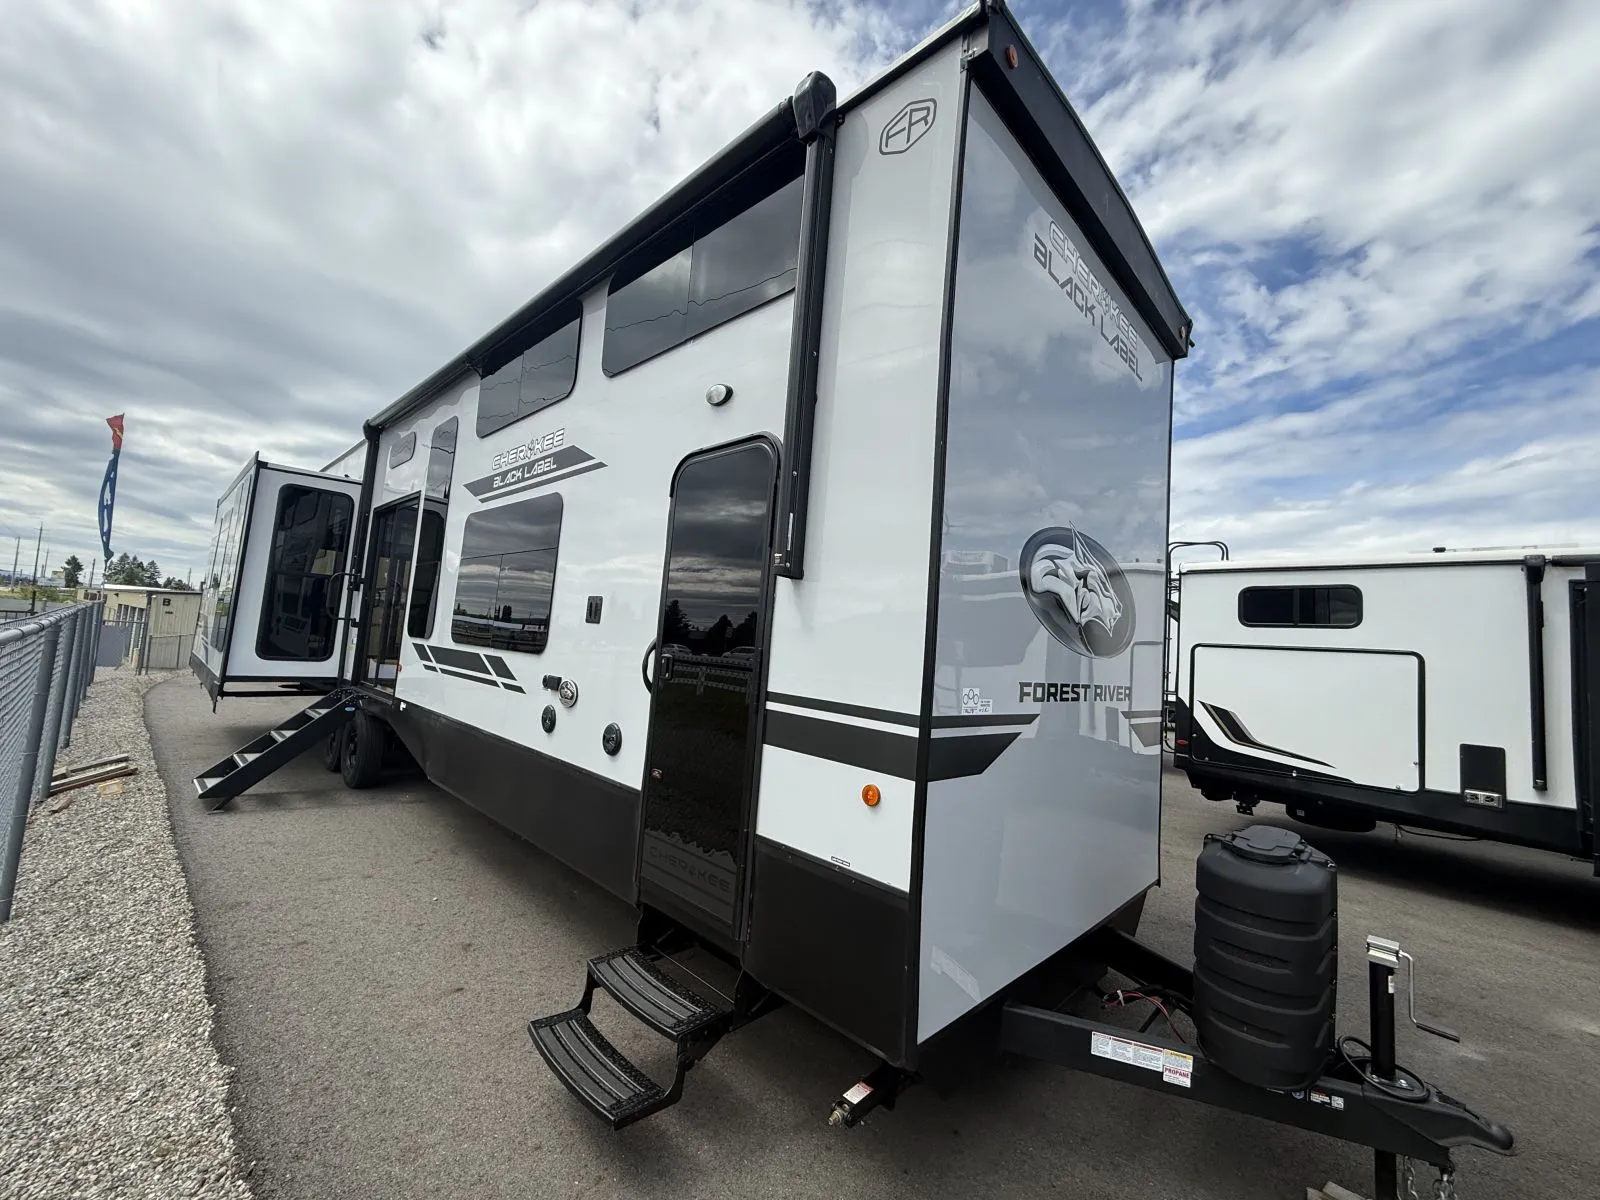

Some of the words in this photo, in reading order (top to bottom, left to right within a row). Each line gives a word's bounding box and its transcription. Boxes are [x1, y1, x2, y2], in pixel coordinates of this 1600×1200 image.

[1033, 232, 1096, 326] BLACK
[1100, 314, 1143, 382] LABEL
[493, 468, 523, 488] BLACK
[525, 457, 557, 477] LABEL
[1019, 681, 1091, 703] FOREST
[1093, 684, 1131, 702] RIVER
[1164, 1067, 1190, 1079] PROPANE
